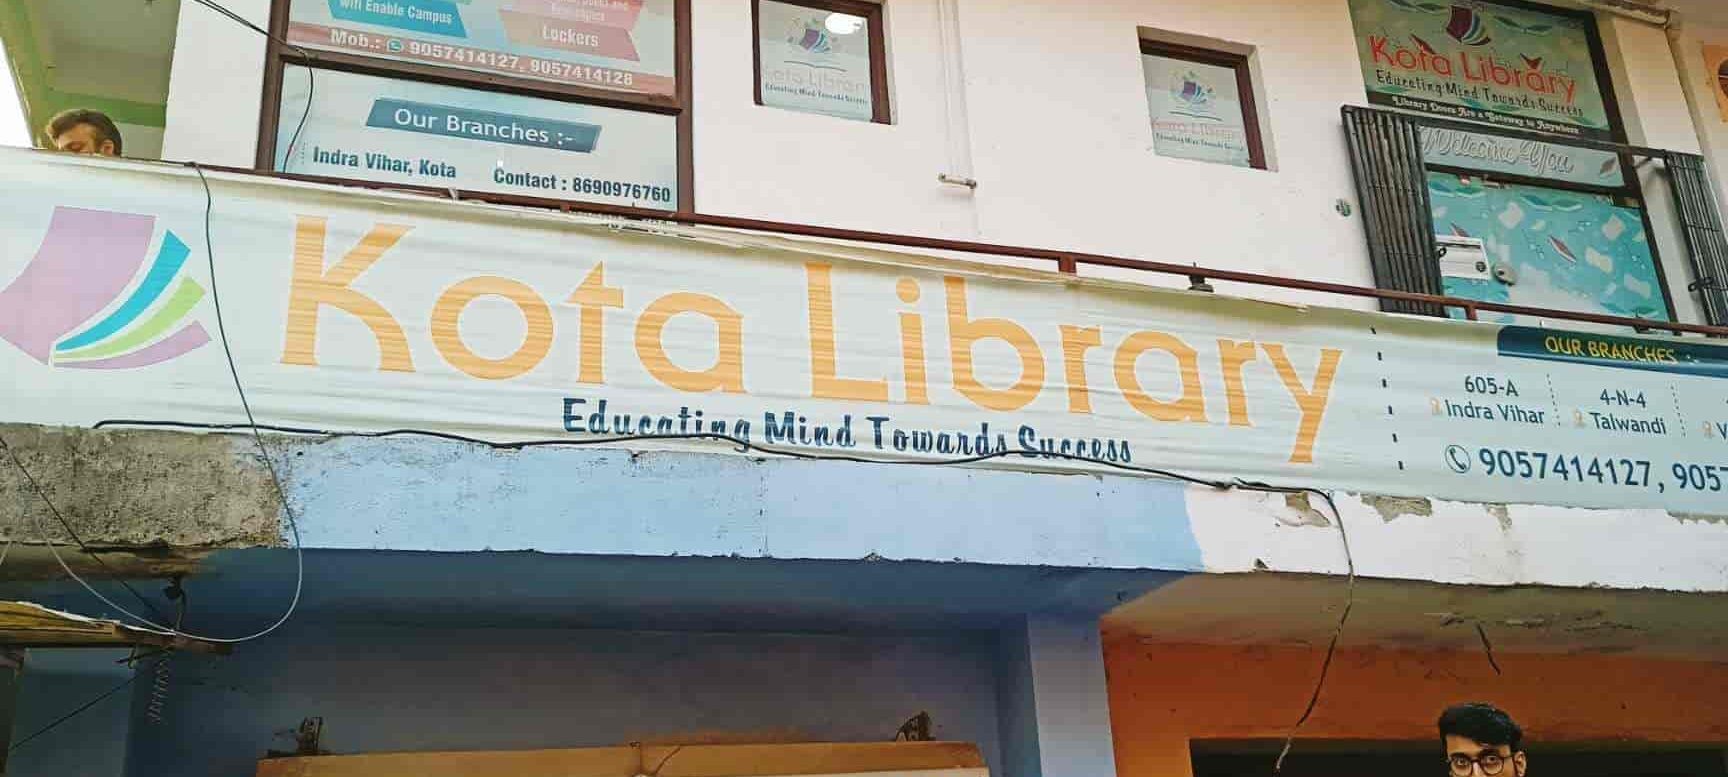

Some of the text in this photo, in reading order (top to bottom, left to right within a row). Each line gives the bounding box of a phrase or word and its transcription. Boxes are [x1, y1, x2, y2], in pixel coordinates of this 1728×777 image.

[366, 1, 404, 16] Enable
[407, 6, 453, 26] Campus
[542, 25, 600, 47] Lockers
[531, 59, 633, 86] 9057414128
[1367, 34, 1577, 103] Kota Library
[1376, 69, 1443, 97] Educating
[1445, 82, 1478, 100] Mind
[1484, 87, 1535, 110] Towards
[394, 109, 438, 131] Our
[446, 116, 549, 144] Branches
[313, 147, 457, 179] Indra Vihar, Kota
[493, 168, 556, 191] Contact
[573, 180, 671, 203] 8690976760
[278, 214, 1343, 463] Kota Library
[1544, 336, 1583, 355] OUR
[1588, 340, 1679, 365] BRANCHES
[1464, 376, 1519, 398] 605-A
[1600, 388, 1647, 408] 4-N-4
[1444, 400, 1545, 424] Indra Vihar
[1590, 412, 1667, 435] Talwandi
[563, 397, 1133, 464] Educating Mind Towards Success
